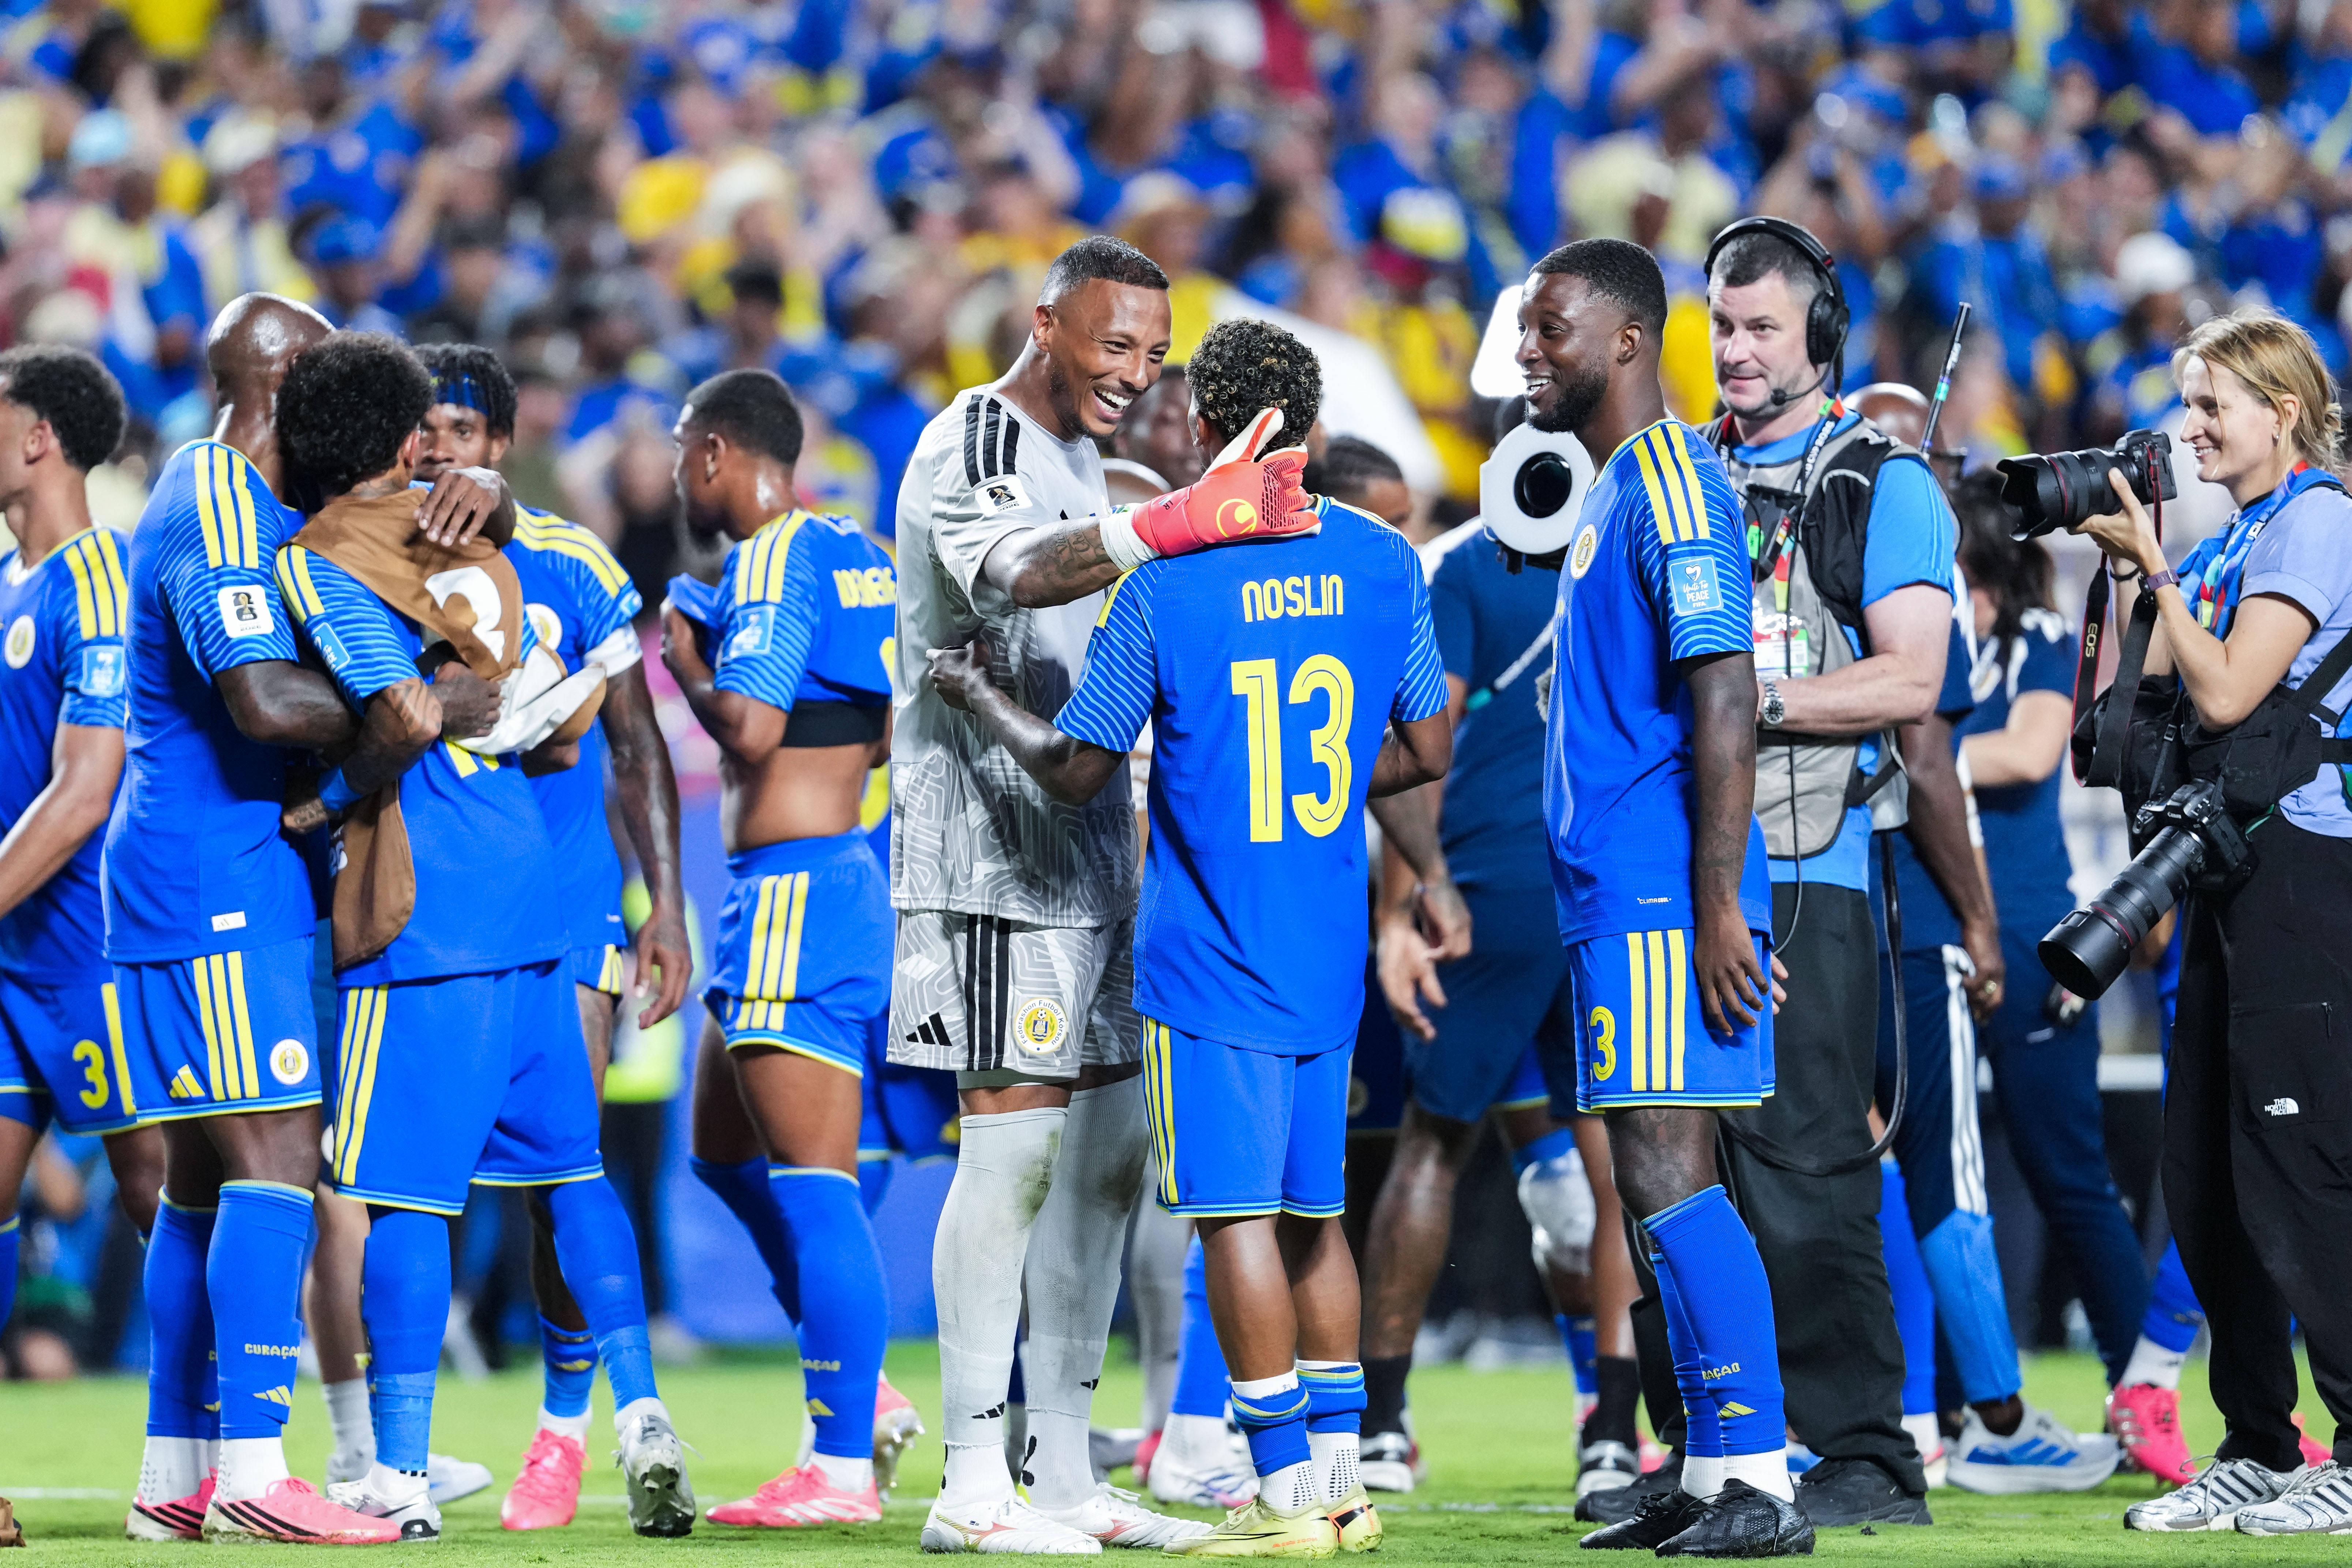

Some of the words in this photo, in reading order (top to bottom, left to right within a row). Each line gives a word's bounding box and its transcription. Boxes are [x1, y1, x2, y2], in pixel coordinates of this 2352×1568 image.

[1815, 421, 1835, 447] 2026
[998, 503, 1019, 512] 2026
[1241, 574, 1343, 622] NOSLIN
[1683, 582, 1700, 594] Unite
[1699, 580, 1708, 590] For
[1686, 590, 1710, 603] PEACE
[2085, 623, 2098, 657] EOS
[1231, 654, 1354, 842] 13
[1017, 1002, 1036, 1044] Federashon
[72, 1039, 109, 1110] 3
[2264, 1104, 2287, 1112] NORTH
